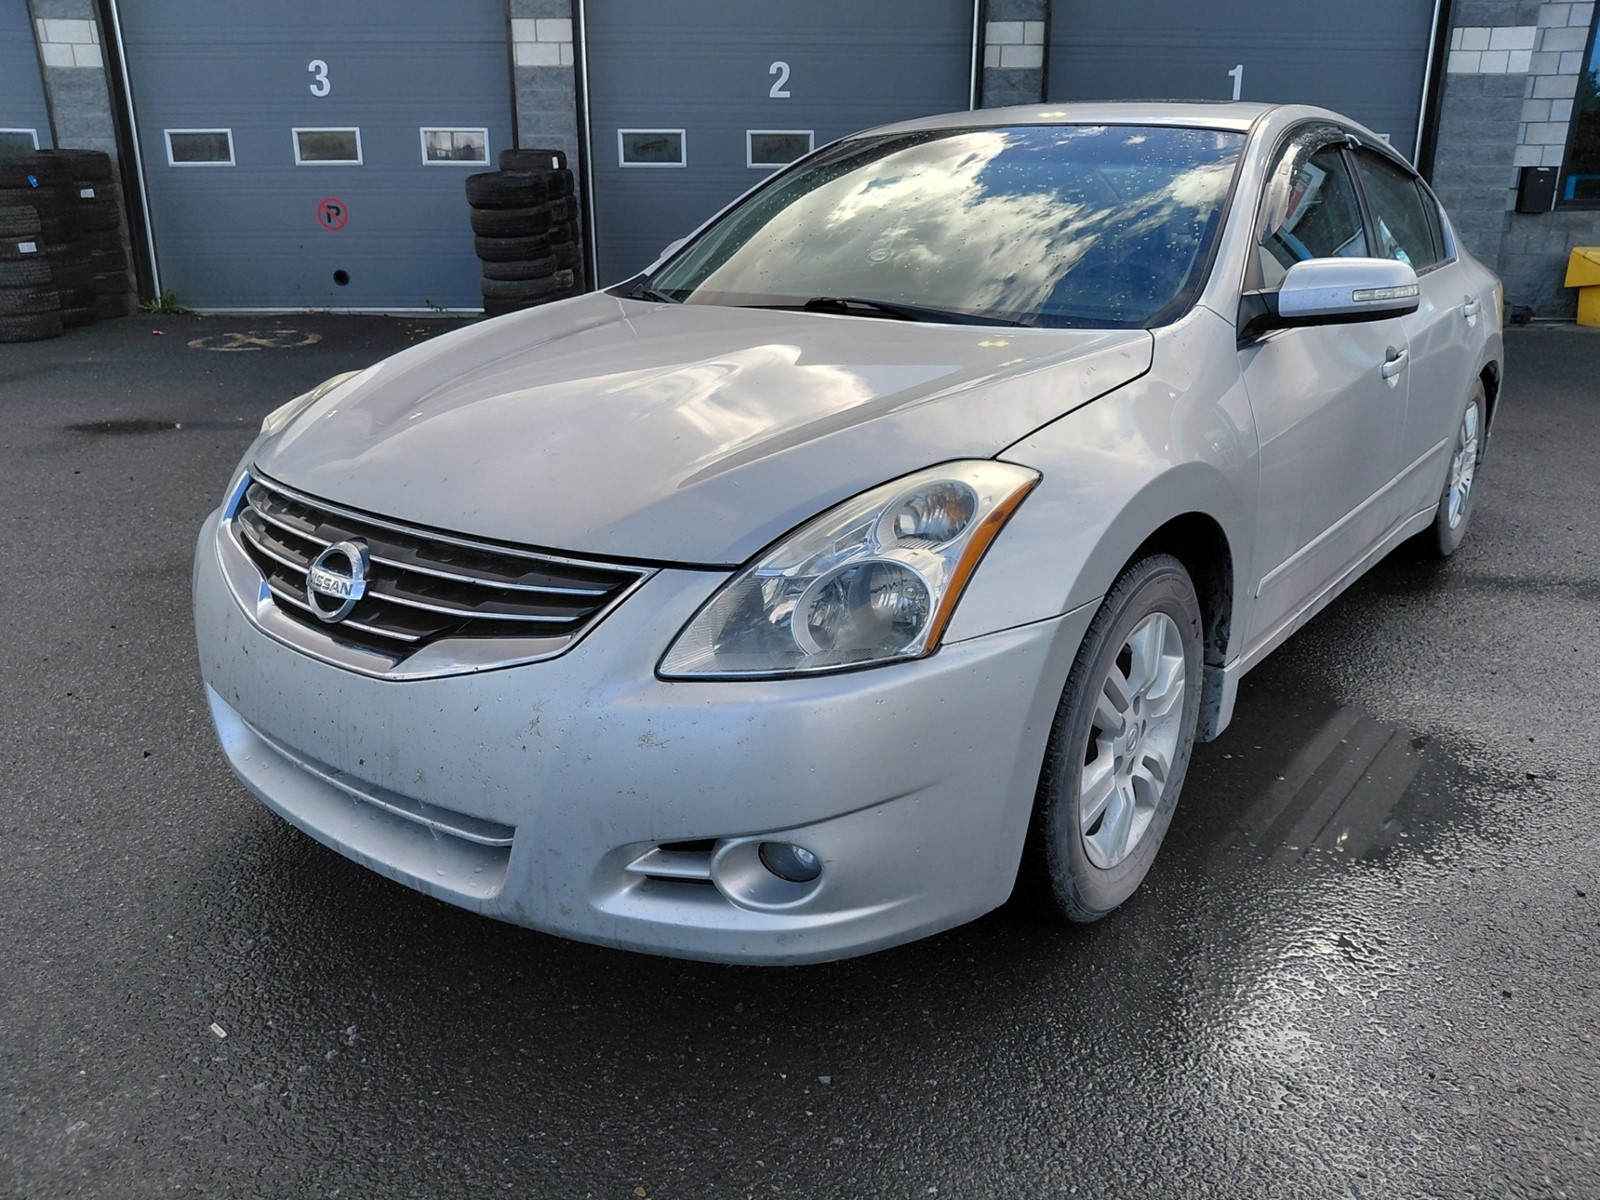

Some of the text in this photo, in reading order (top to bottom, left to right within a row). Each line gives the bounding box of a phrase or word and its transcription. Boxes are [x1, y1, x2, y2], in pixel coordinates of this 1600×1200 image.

[308, 59, 331, 97] 3
[769, 61, 791, 98] 2
[1228, 64, 1244, 101] 1
[309, 568, 353, 596] NISSAN
